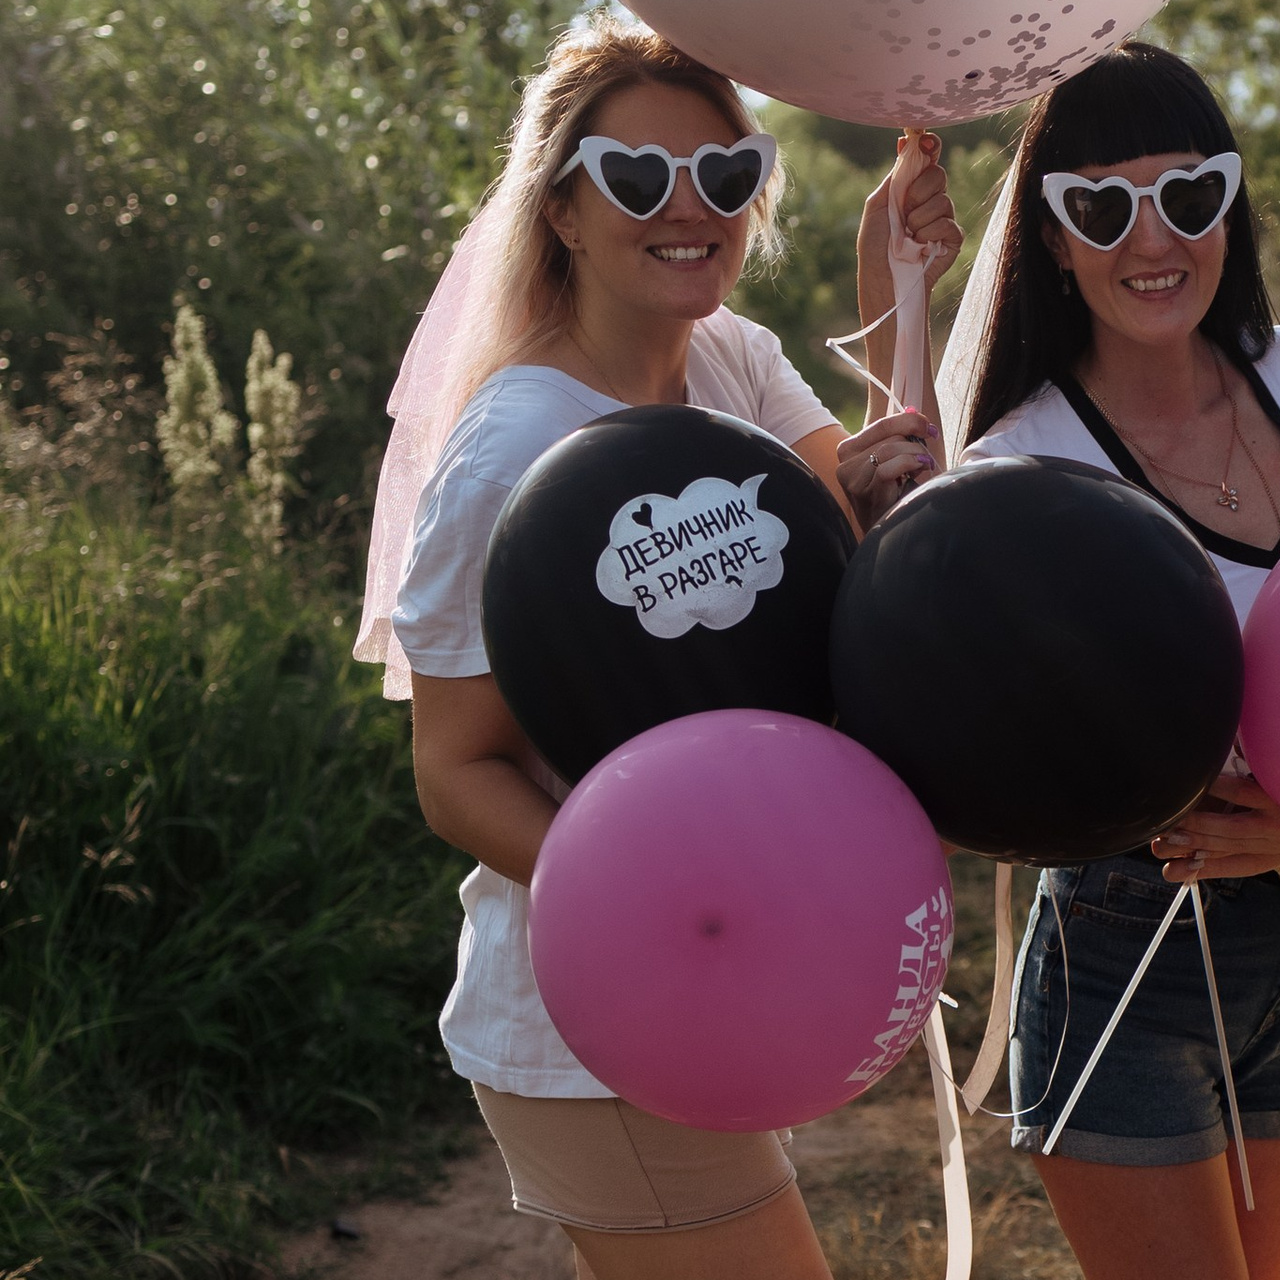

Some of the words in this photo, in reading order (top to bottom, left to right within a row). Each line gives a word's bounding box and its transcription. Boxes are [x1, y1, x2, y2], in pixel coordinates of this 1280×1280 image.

[617, 498, 755, 581] ДЕВИЧНИК
[632, 584, 657, 613] В
[658, 536, 768, 600] РАЗГАРЕ
[844, 901, 929, 1083] БАНДА
[881, 923, 942, 1068] НЕВЕСТЫ
